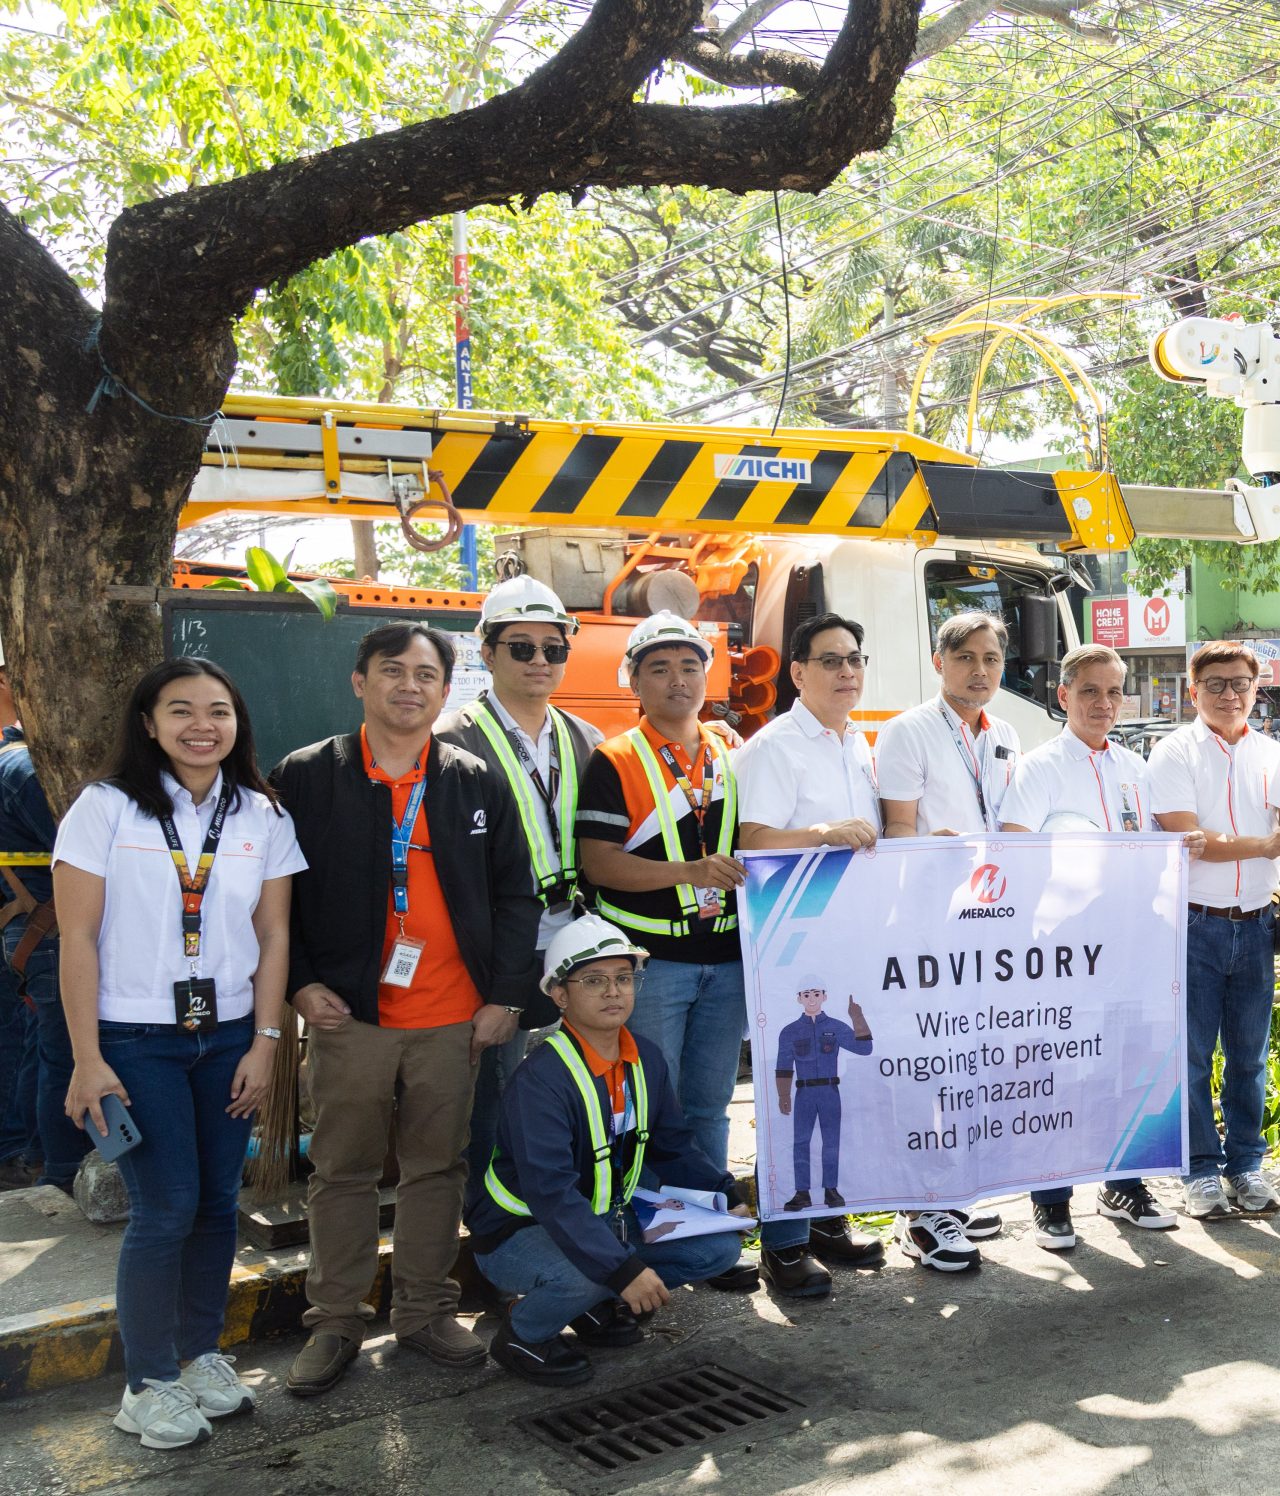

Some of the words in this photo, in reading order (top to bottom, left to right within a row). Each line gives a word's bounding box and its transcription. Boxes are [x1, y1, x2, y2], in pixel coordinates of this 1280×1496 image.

[733, 459, 805, 479] AICHI
[1096, 608, 1121, 617] HOME
[1096, 617, 1124, 627] CREDIT
[958, 906, 1015, 919] MERALCO
[882, 944, 1103, 990] ADVISORY
[916, 1011, 970, 1038] Wire
[975, 1002, 1073, 1030] clearing
[879, 1048, 978, 1081] ongoing
[980, 1043, 1005, 1067] to
[1015, 1033, 1102, 1069] prevent
[937, 1085, 974, 1112] fire
[977, 1071, 1054, 1104] hazard
[907, 1123, 957, 1151] and
[968, 1115, 1003, 1152] pole
[1012, 1110, 1073, 1135] down
